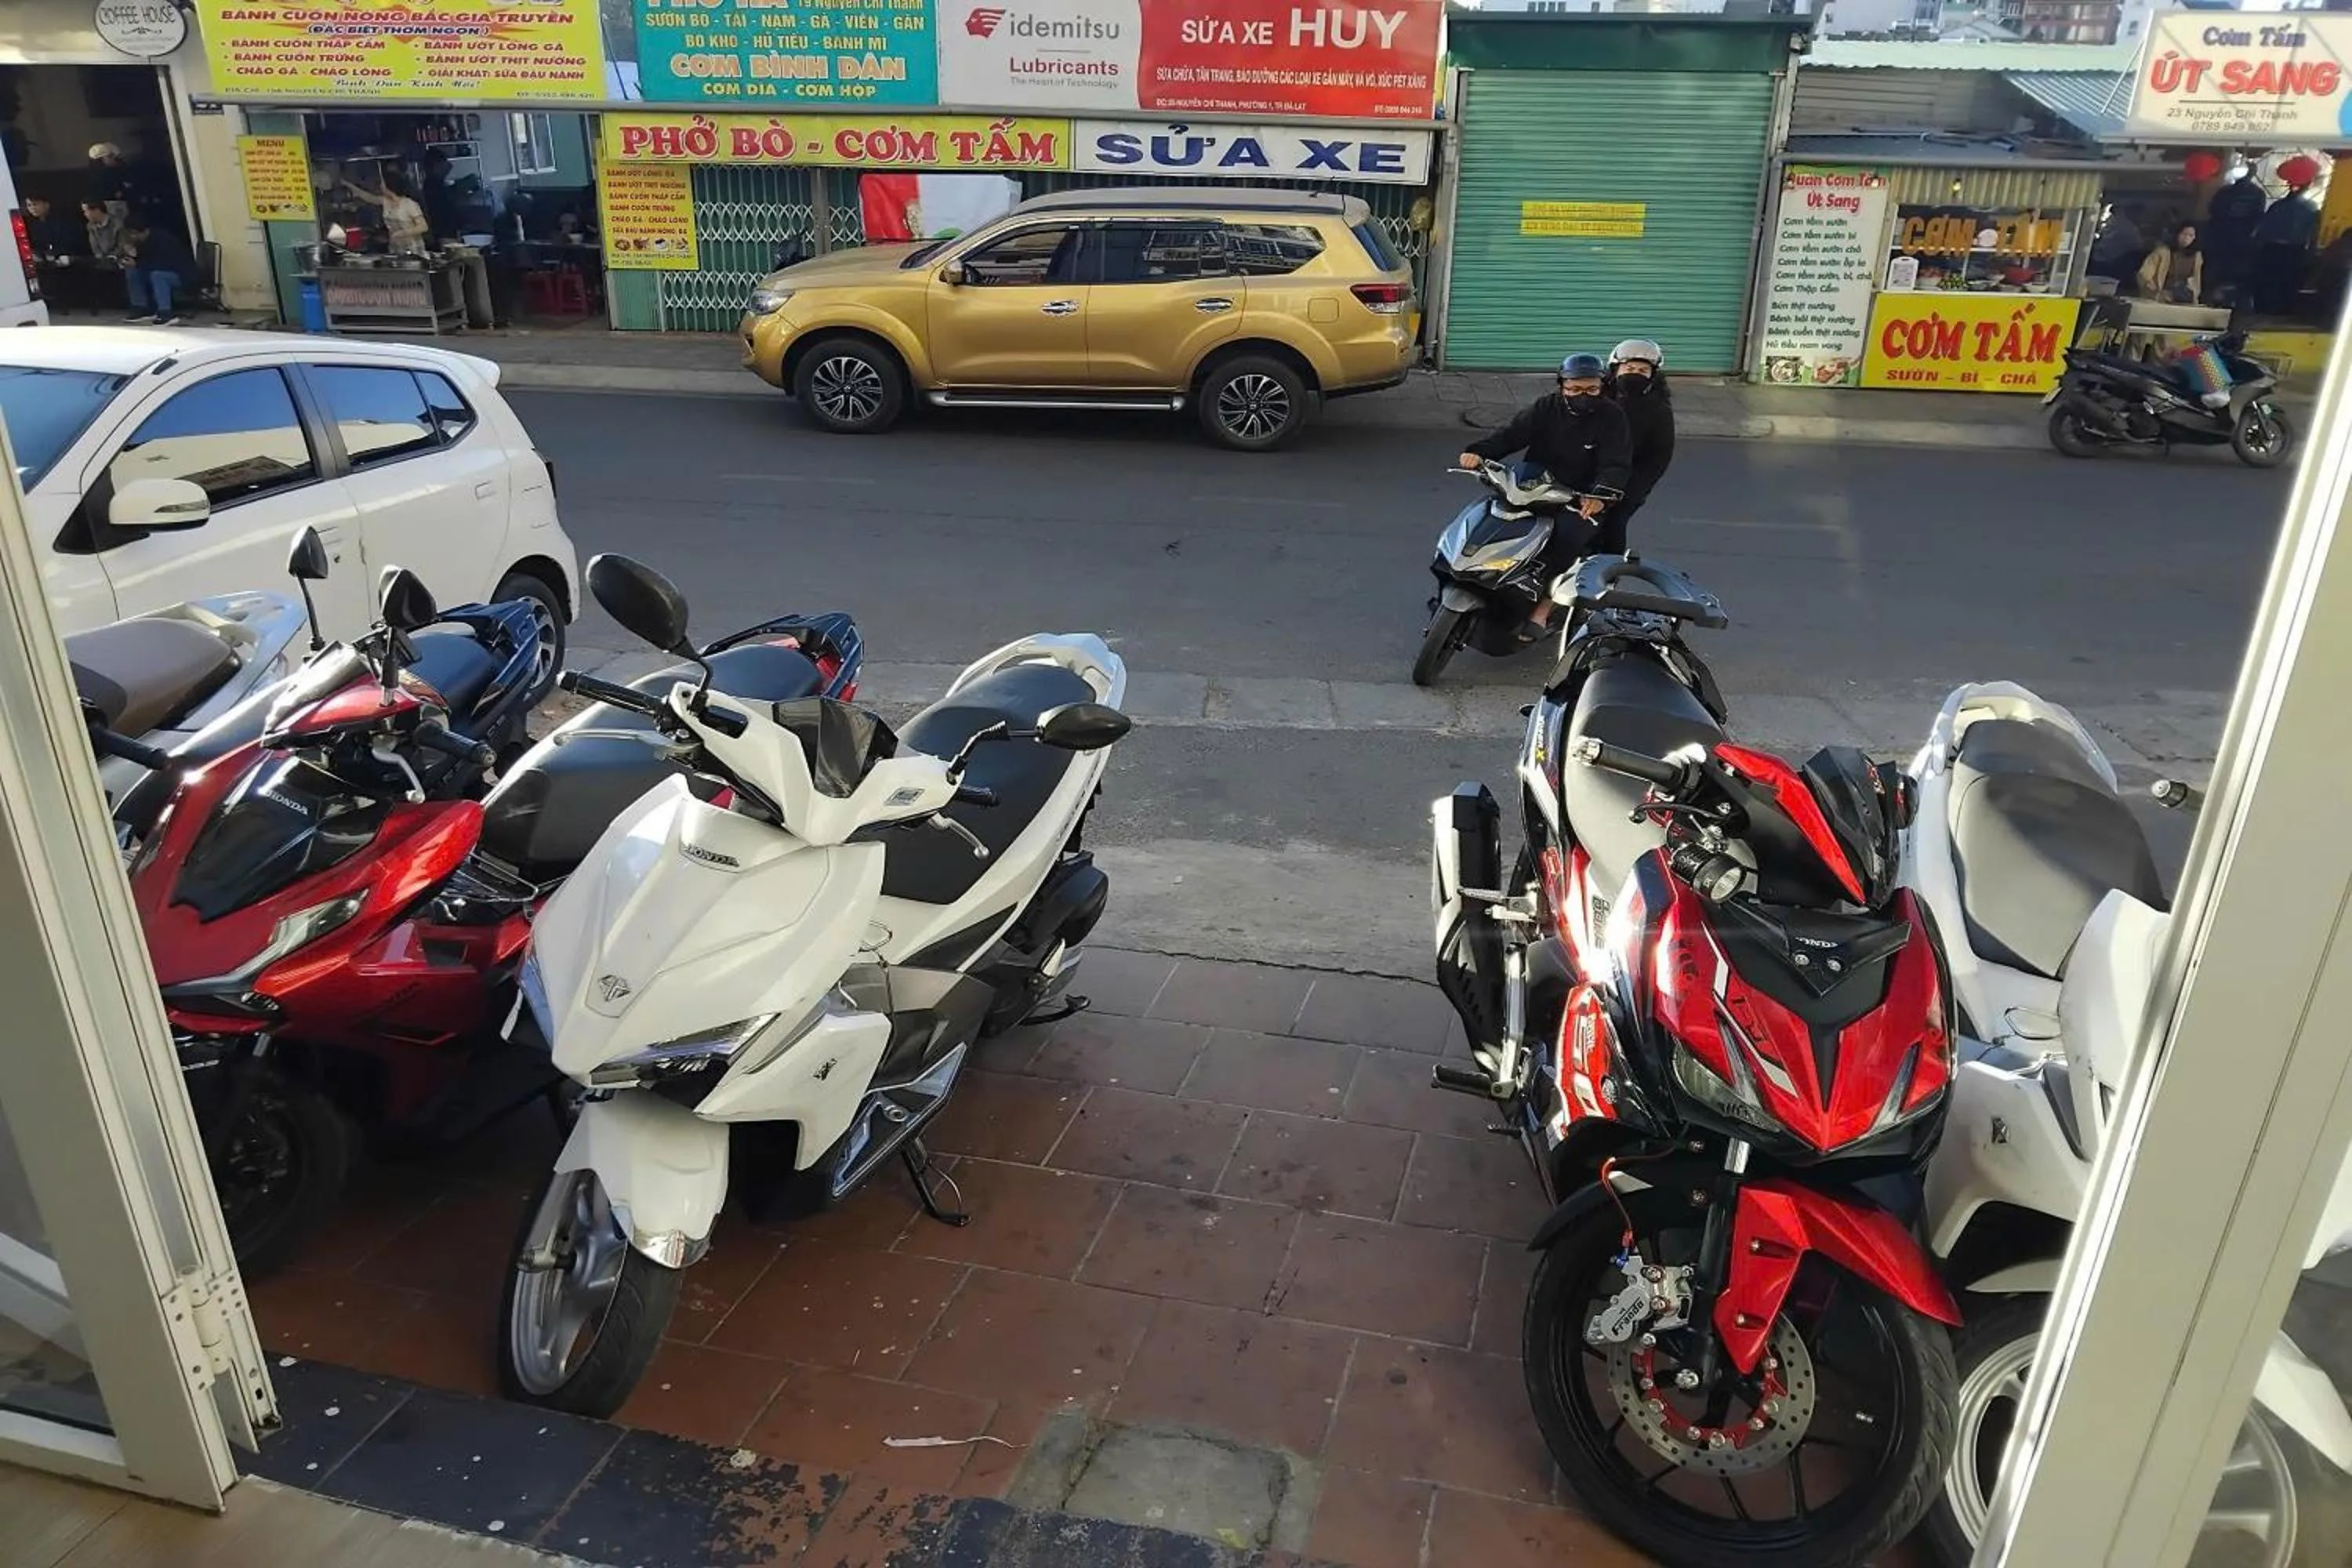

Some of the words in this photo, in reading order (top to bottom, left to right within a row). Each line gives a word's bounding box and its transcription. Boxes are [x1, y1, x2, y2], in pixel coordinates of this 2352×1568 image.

[99, 5, 140, 25] COFFEE
[141, 5, 176, 24] HOUSE
[456, 13, 491, 22] GIA
[1010, 13, 1120, 39] idemitsu
[1181, 15, 1236, 44] SỬA
[1242, 21, 1273, 44] XE
[1290, 8, 1407, 49] HUY
[2260, 24, 2306, 46] Tấm
[670, 53, 742, 78] CƠM
[750, 50, 829, 79] BÌNH
[837, 53, 906, 80] DÂN
[1010, 56, 1119, 76] Lubricants
[2151, 50, 2212, 93] ÚT
[2220, 60, 2342, 96] SANG
[1066, 78, 1118, 89] Technology
[619, 115, 718, 158] PHỞ
[731, 118, 794, 158] BÒ
[834, 125, 938, 162] CƠM
[949, 117, 1056, 162] TẤM
[1095, 124, 1269, 167] SỬA
[1295, 139, 1406, 173] XE
[1826, 193, 1860, 213] Sang
[1882, 311, 1966, 361] CƠM
[1974, 303, 2062, 363] TẤM
[1886, 368, 1938, 382] SƯỜN
